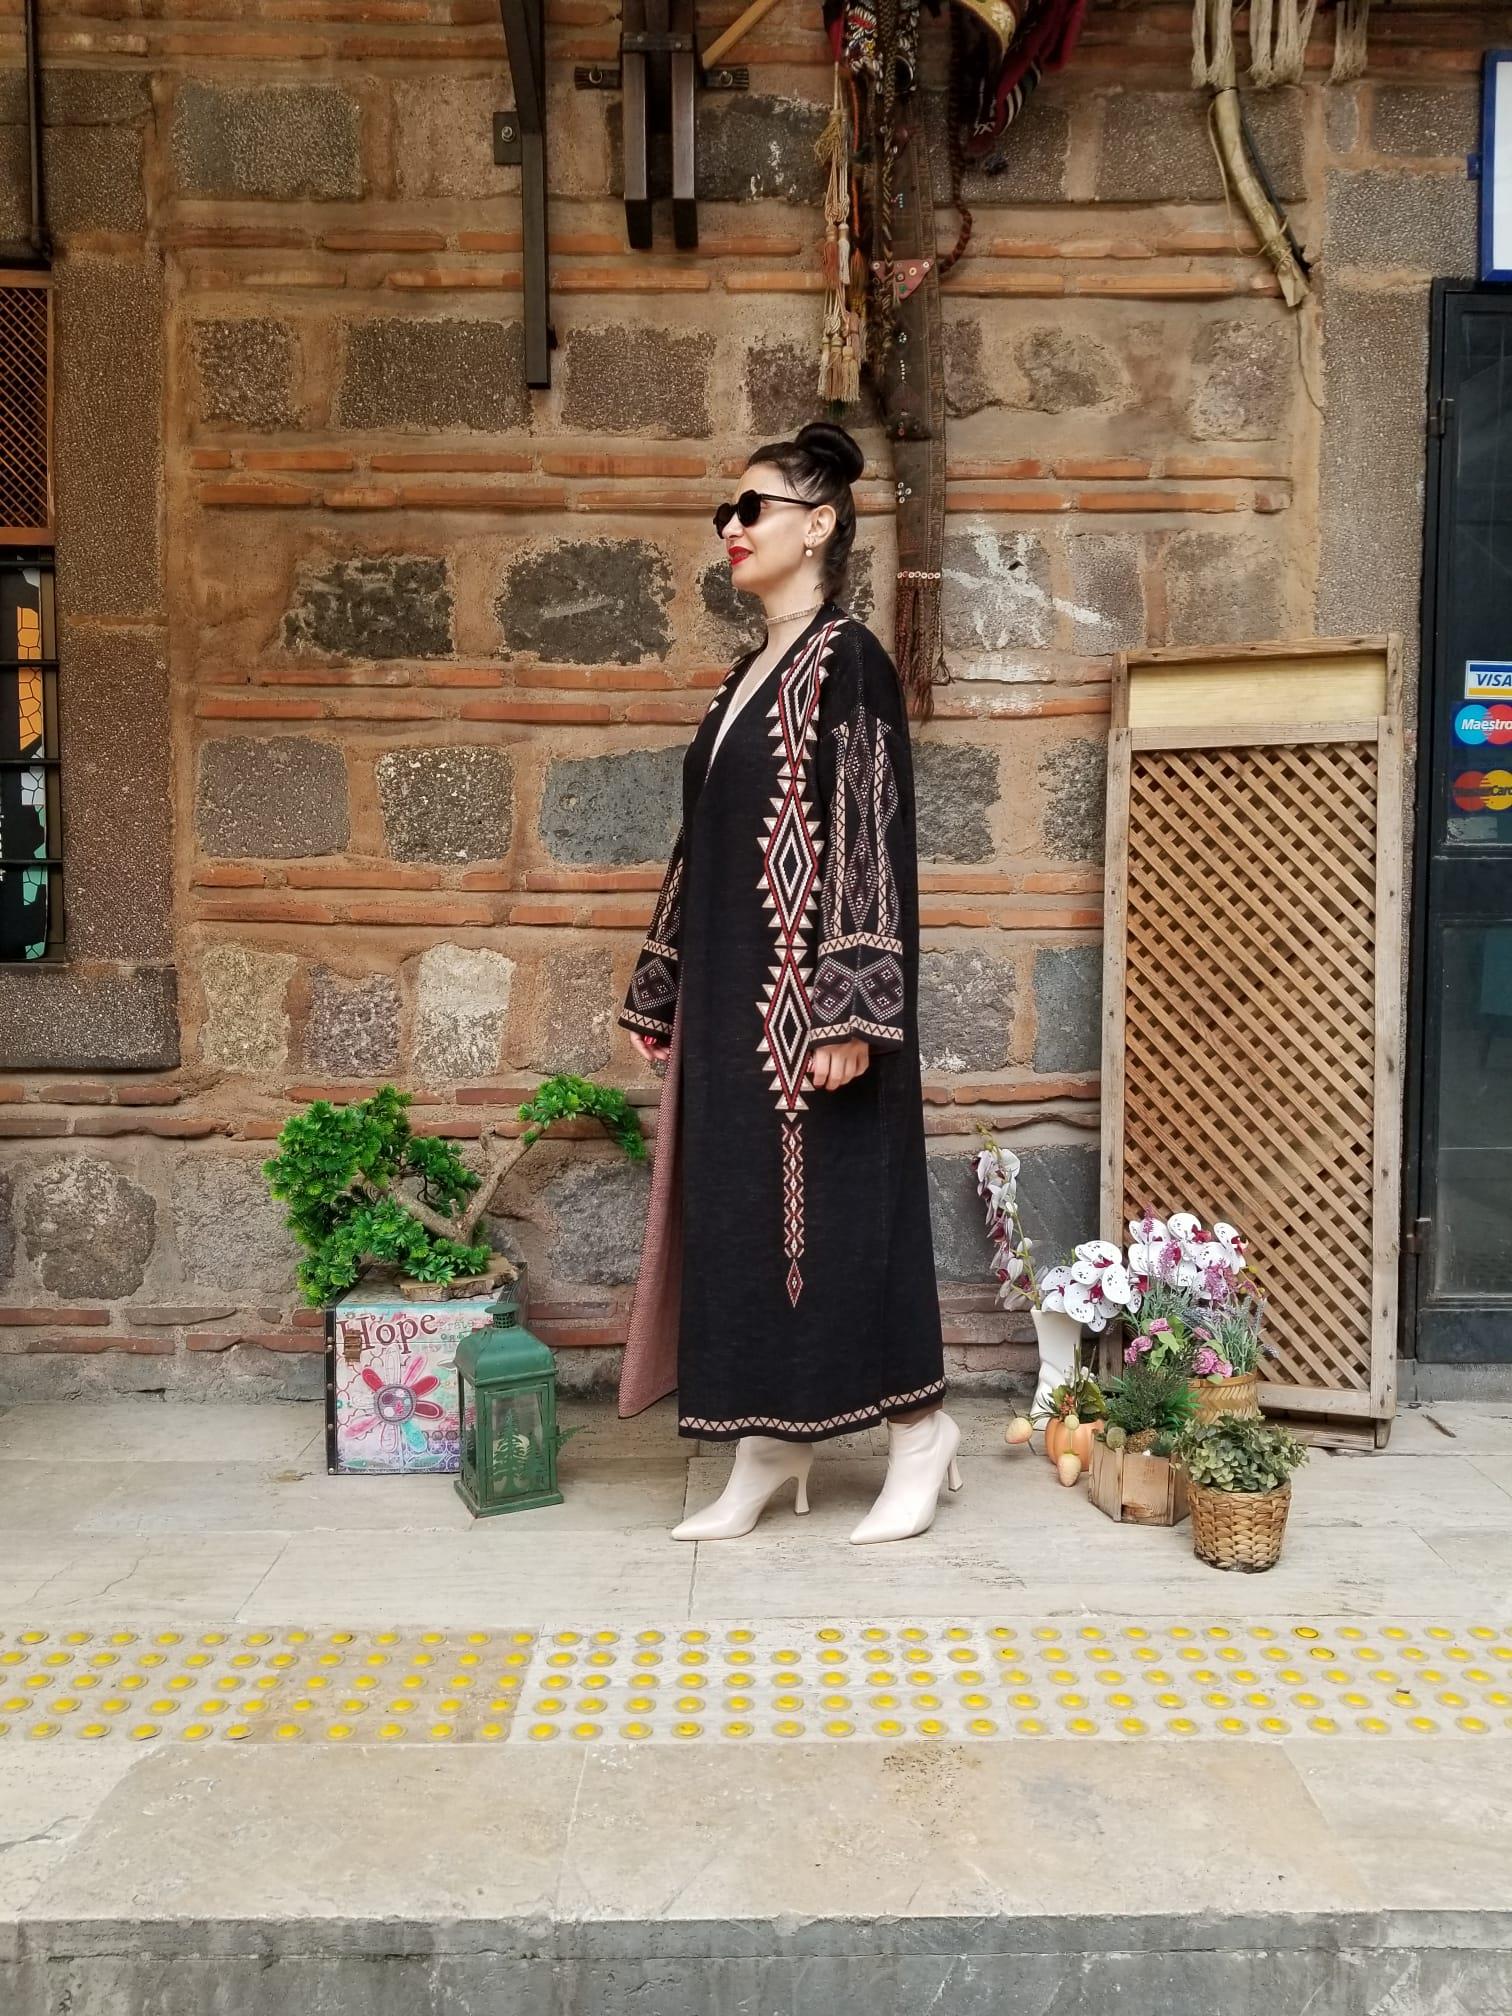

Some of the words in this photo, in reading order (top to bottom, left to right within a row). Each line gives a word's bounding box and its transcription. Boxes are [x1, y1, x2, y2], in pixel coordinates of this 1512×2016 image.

[1476, 673, 1512, 687] VISA
[1461, 718, 1512, 730] Maestro
[336, 1313, 438, 1355] Hope
